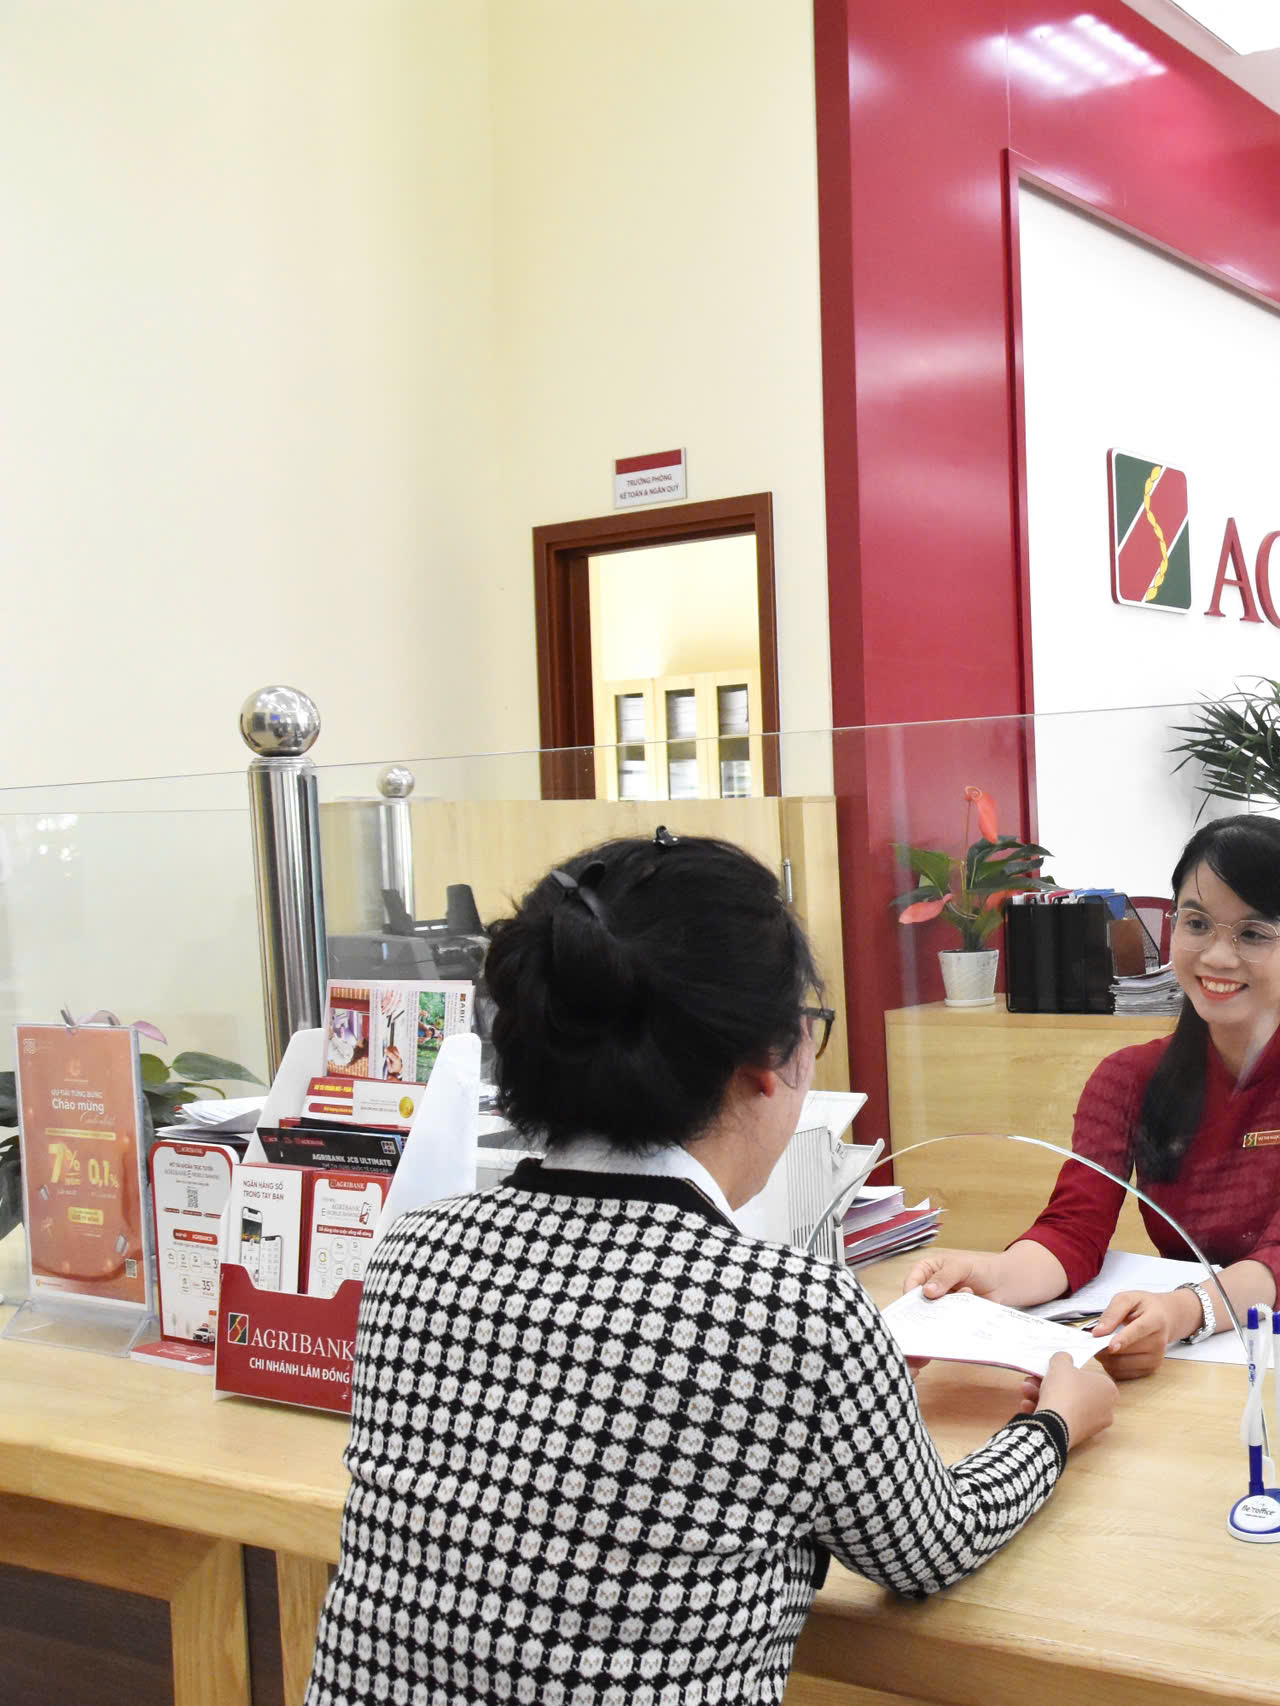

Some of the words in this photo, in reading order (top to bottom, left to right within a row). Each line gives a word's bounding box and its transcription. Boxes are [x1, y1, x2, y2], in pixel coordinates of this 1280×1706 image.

[52, 1098, 76, 1110] Chào
[78, 1100, 104, 1114] mừng
[312, 1153, 345, 1163] AGRIBANK
[347, 1156, 358, 1164] JCB
[359, 1157, 392, 1167] ULTIMATE
[336, 1181, 365, 1189] AGRIBANK
[243, 1190, 261, 1198] TRONG
[251, 1327, 355, 1361] AGRIBANK
[249, 1357, 264, 1370] CHI
[266, 1359, 299, 1375] NHÁNH
[300, 1364, 320, 1379] LÂM
[322, 1366, 350, 1384] ĐỒNG
